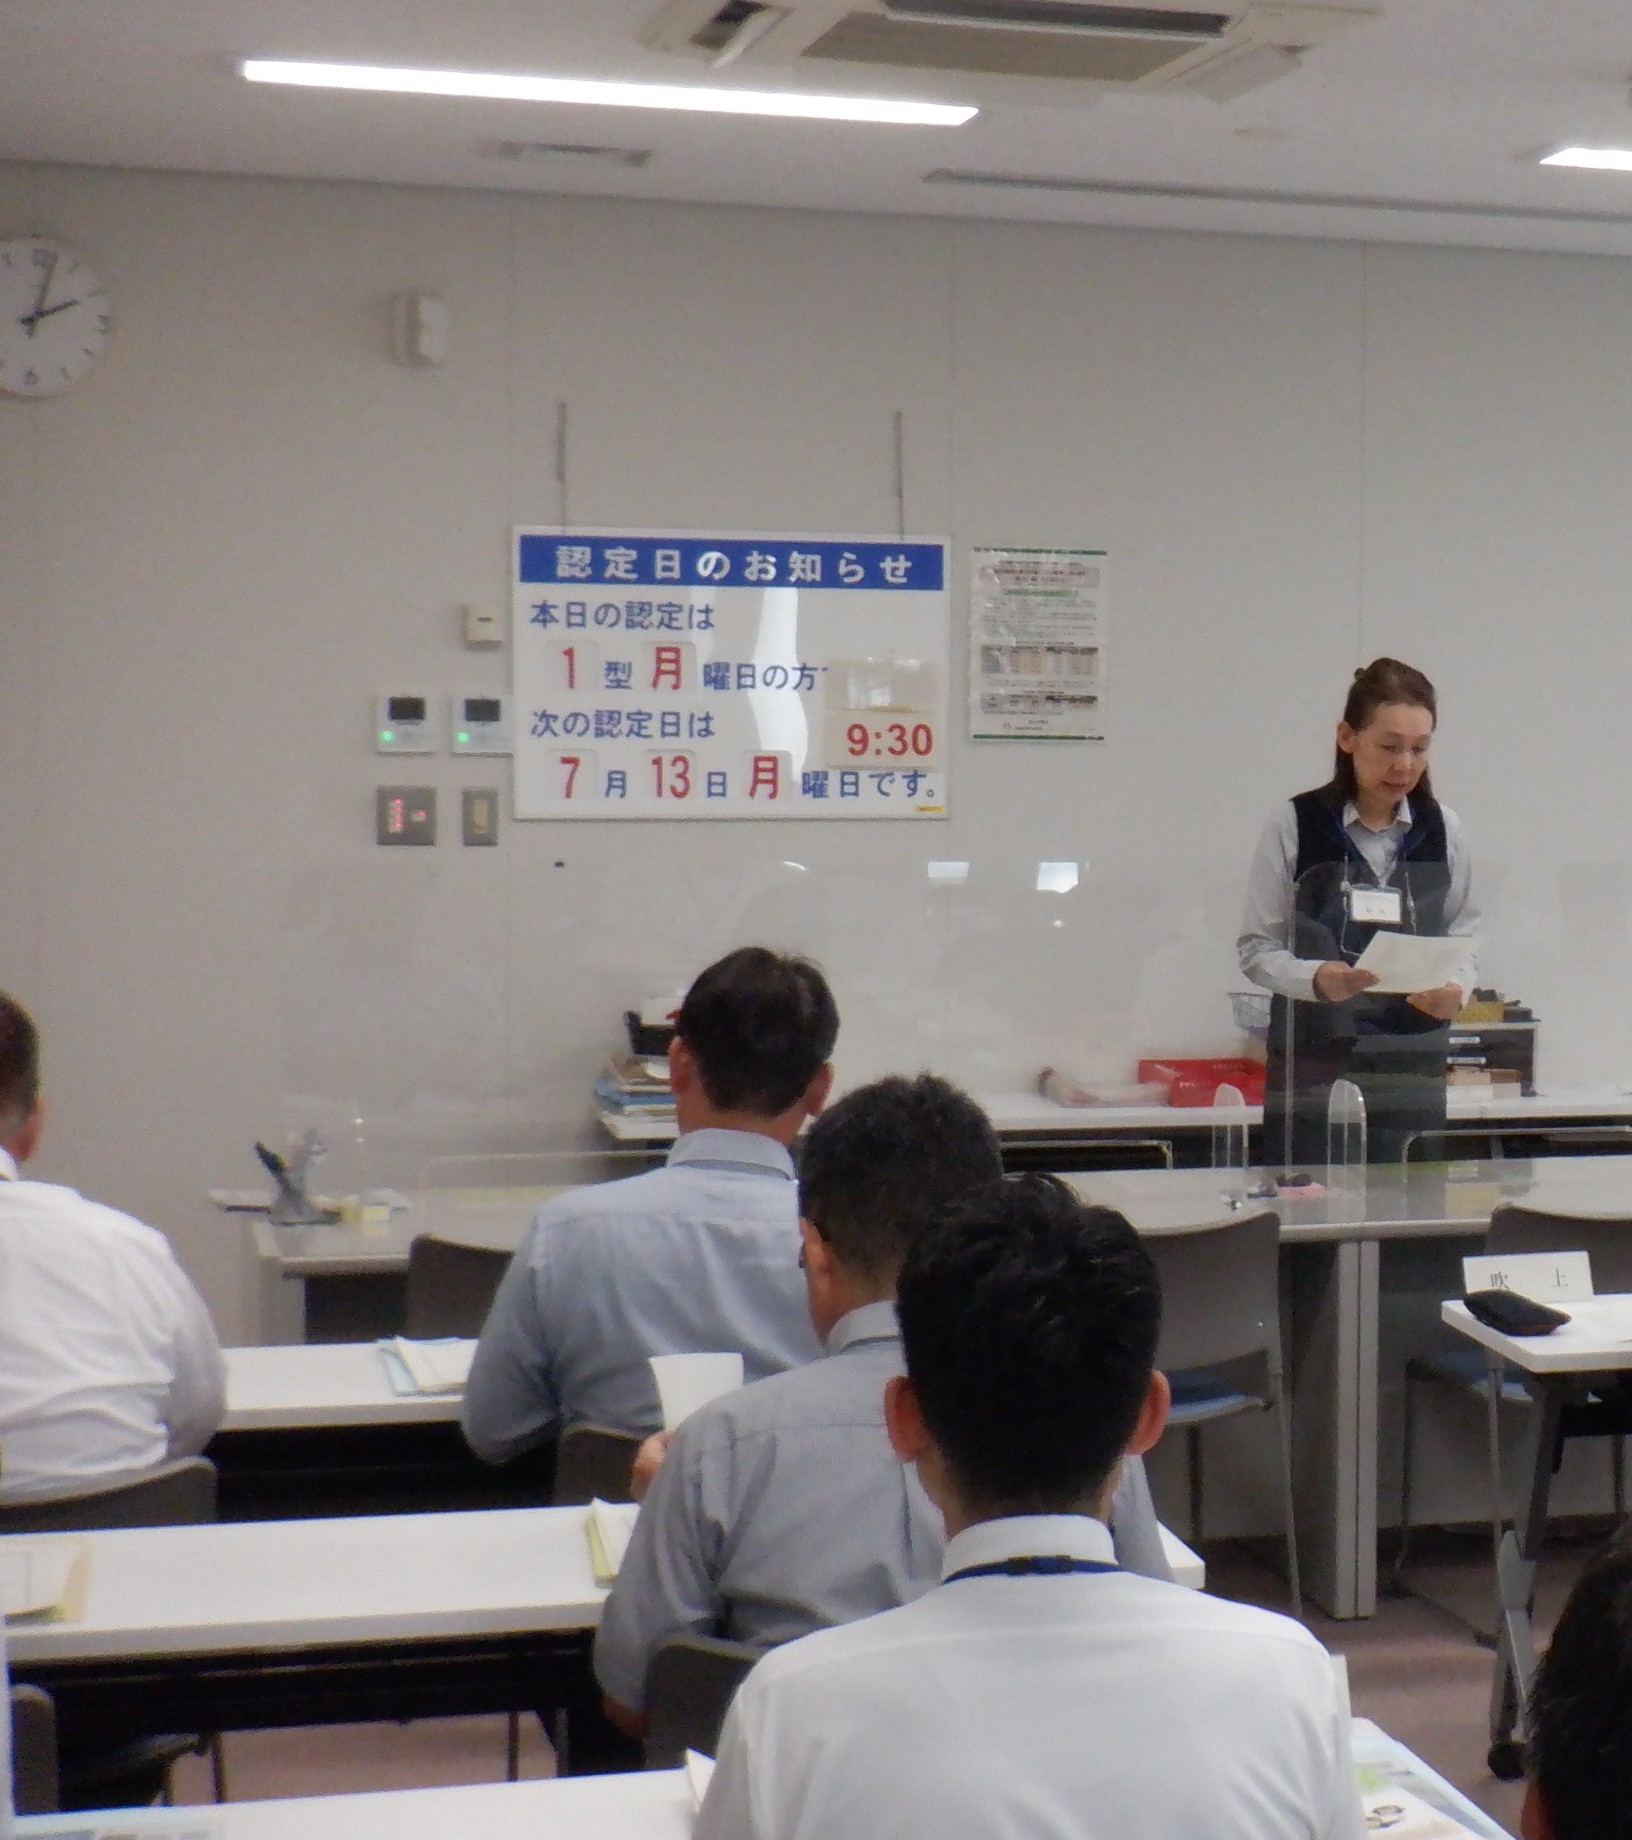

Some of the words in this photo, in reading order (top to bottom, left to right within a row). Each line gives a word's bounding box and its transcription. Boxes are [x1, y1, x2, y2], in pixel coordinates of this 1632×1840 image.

[556, 546, 911, 583] 認定日のお知らせ
[530, 600, 715, 630] 本日の認定は
[561, 647, 576, 689] 1
[703, 662, 828, 690] 曜日の方
[530, 711, 715, 738] 次の認定日は
[846, 723, 934, 757] 9:30
[651, 755, 691, 798] 13
